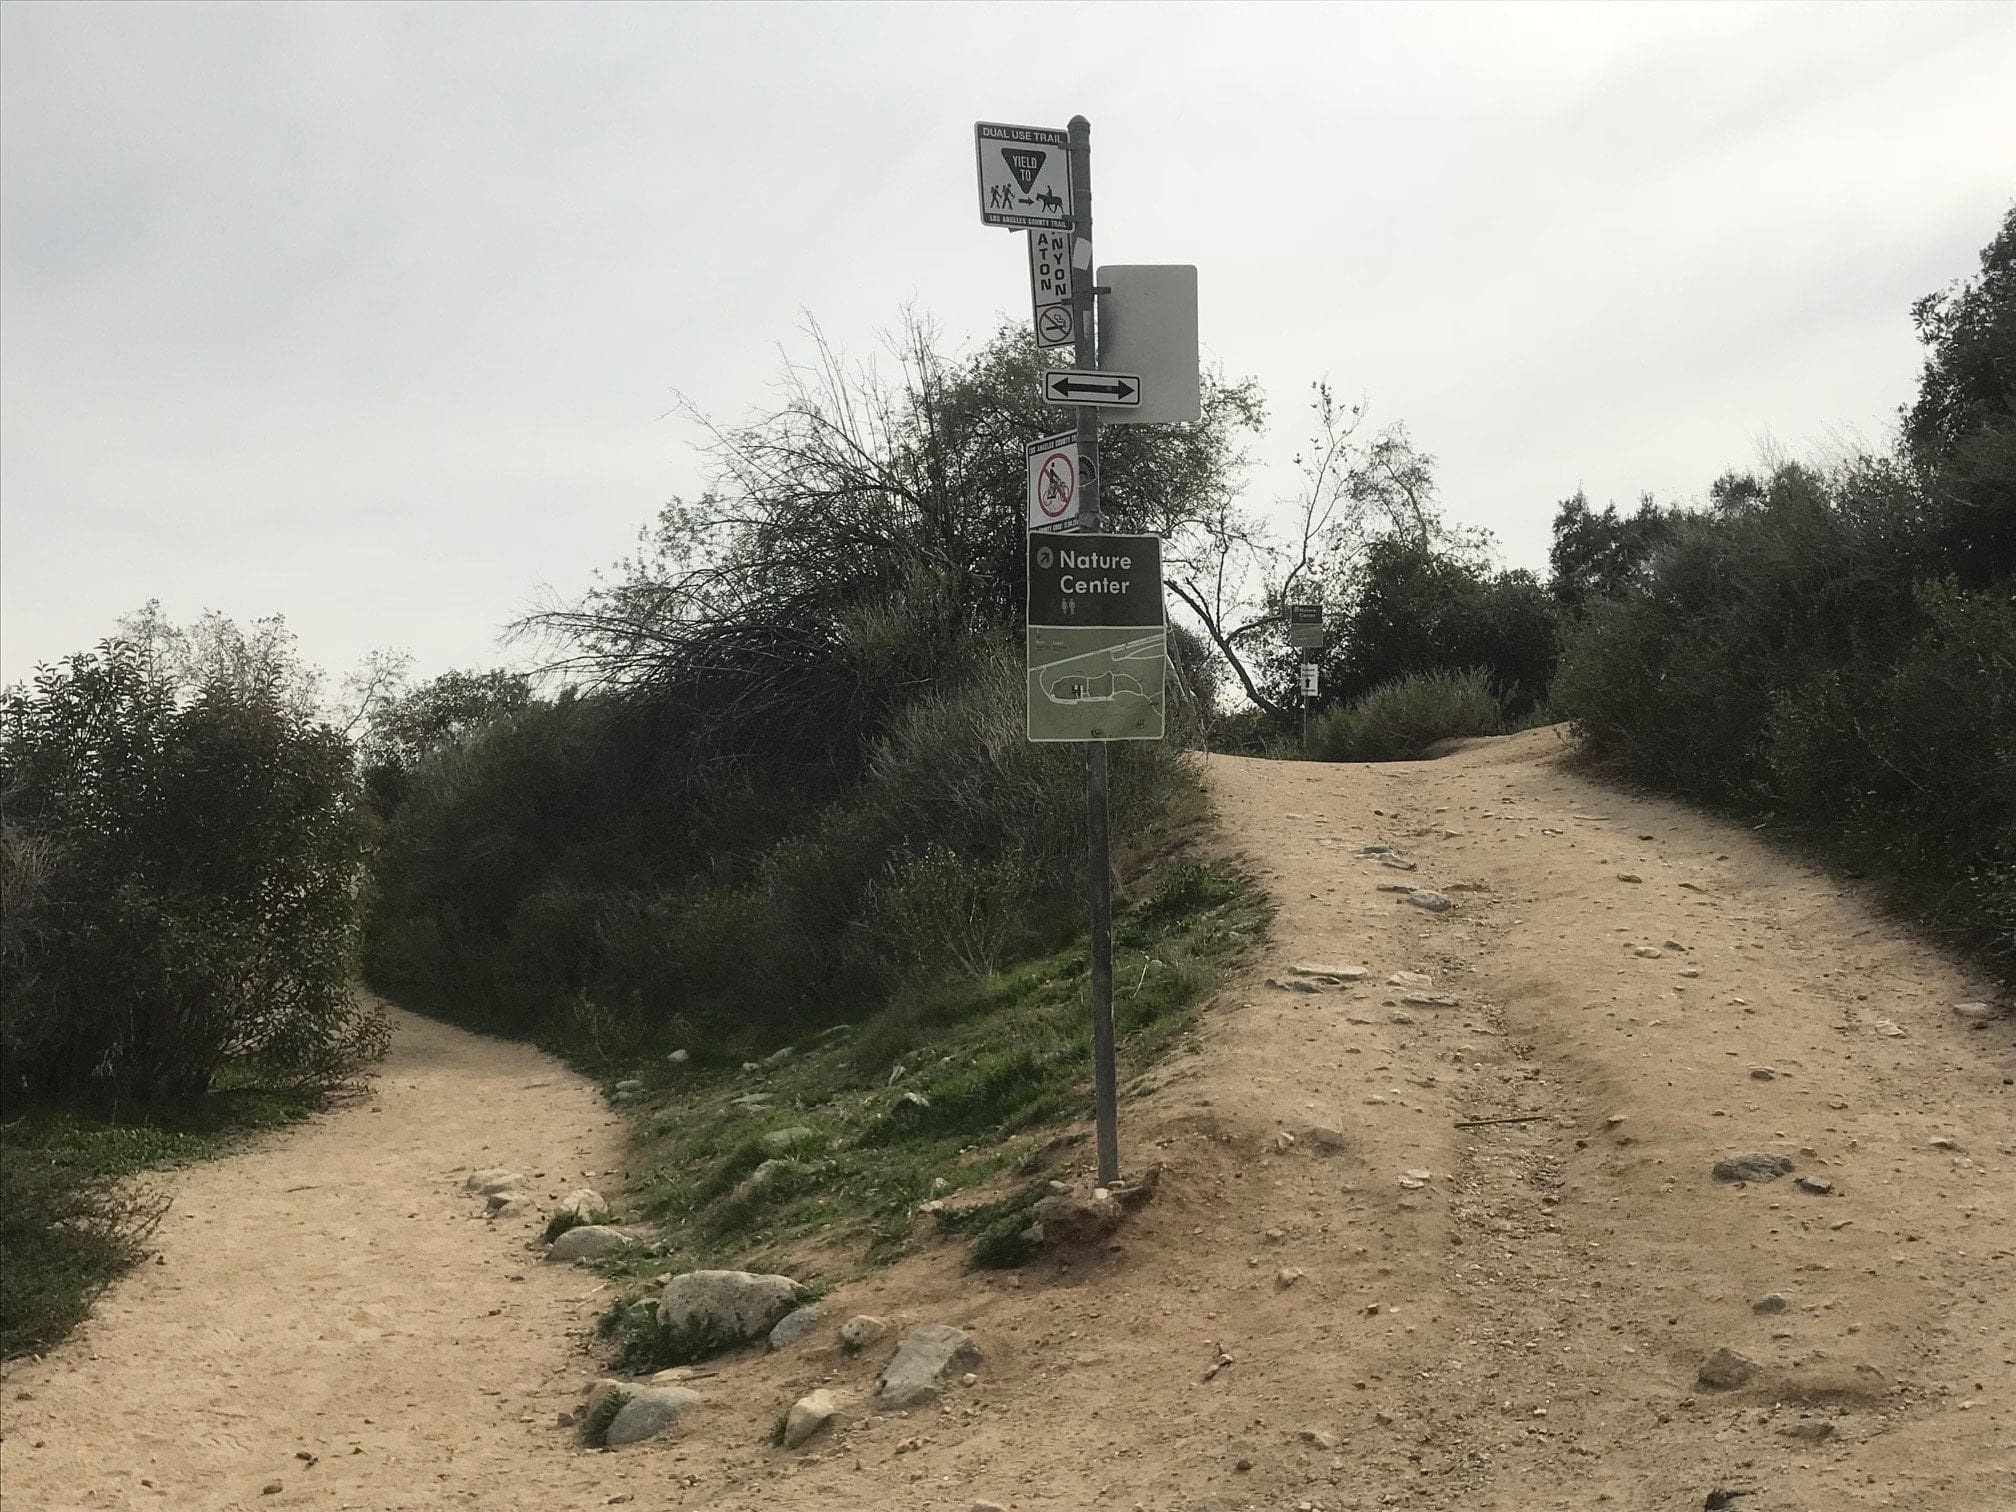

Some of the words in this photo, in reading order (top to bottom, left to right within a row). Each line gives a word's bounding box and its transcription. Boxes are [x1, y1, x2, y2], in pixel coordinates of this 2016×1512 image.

[982, 127, 1010, 139] DUAL
[1011, 130, 1032, 141] USE
[1033, 132, 1064, 144] TRAIL
[1012, 155, 1037, 170] YIELD
[1019, 168, 1032, 182] TO
[1028, 218, 1049, 227] COUNTY
[1050, 219, 1067, 228] TRAIL
[1051, 231, 1067, 296] NYON
[1060, 550, 1132, 570] Nature
[1060, 574, 1130, 594] Center
